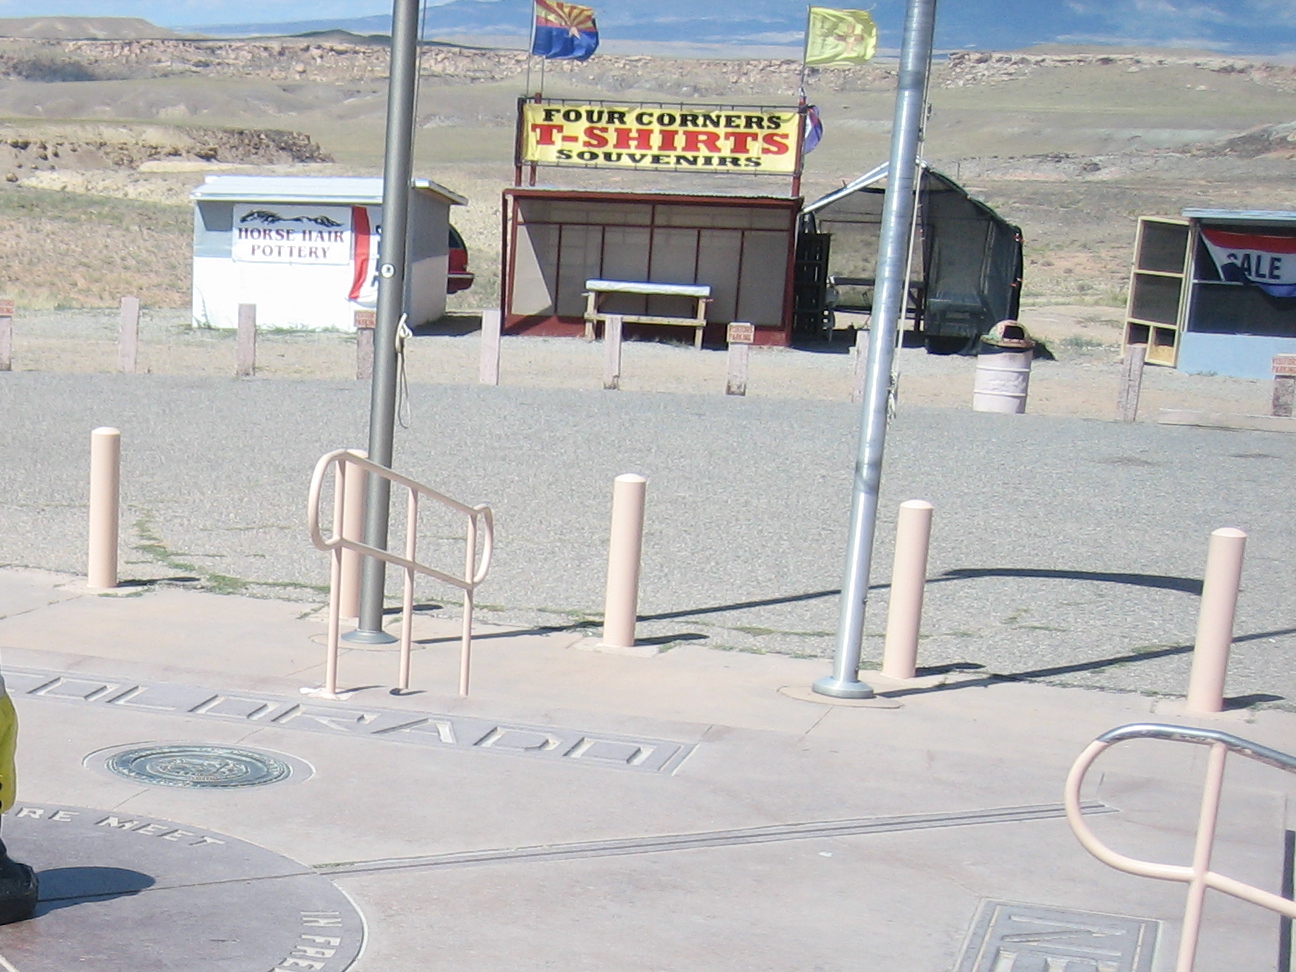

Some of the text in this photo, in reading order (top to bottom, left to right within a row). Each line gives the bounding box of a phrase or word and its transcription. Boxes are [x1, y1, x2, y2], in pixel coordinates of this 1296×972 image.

[543, 108, 782, 130] FOUR CORNERS
[531, 123, 789, 155] T-SHIRTS
[556, 149, 762, 167] SOUVENIRS
[237, 227, 344, 243] HORSE HAIR
[251, 244, 330, 258] POTTERY
[1, 671, 658, 766] OLORADO
[15, 806, 80, 823] RE
[93, 815, 226, 847] MEET
[299, 911, 343, 927] IN
